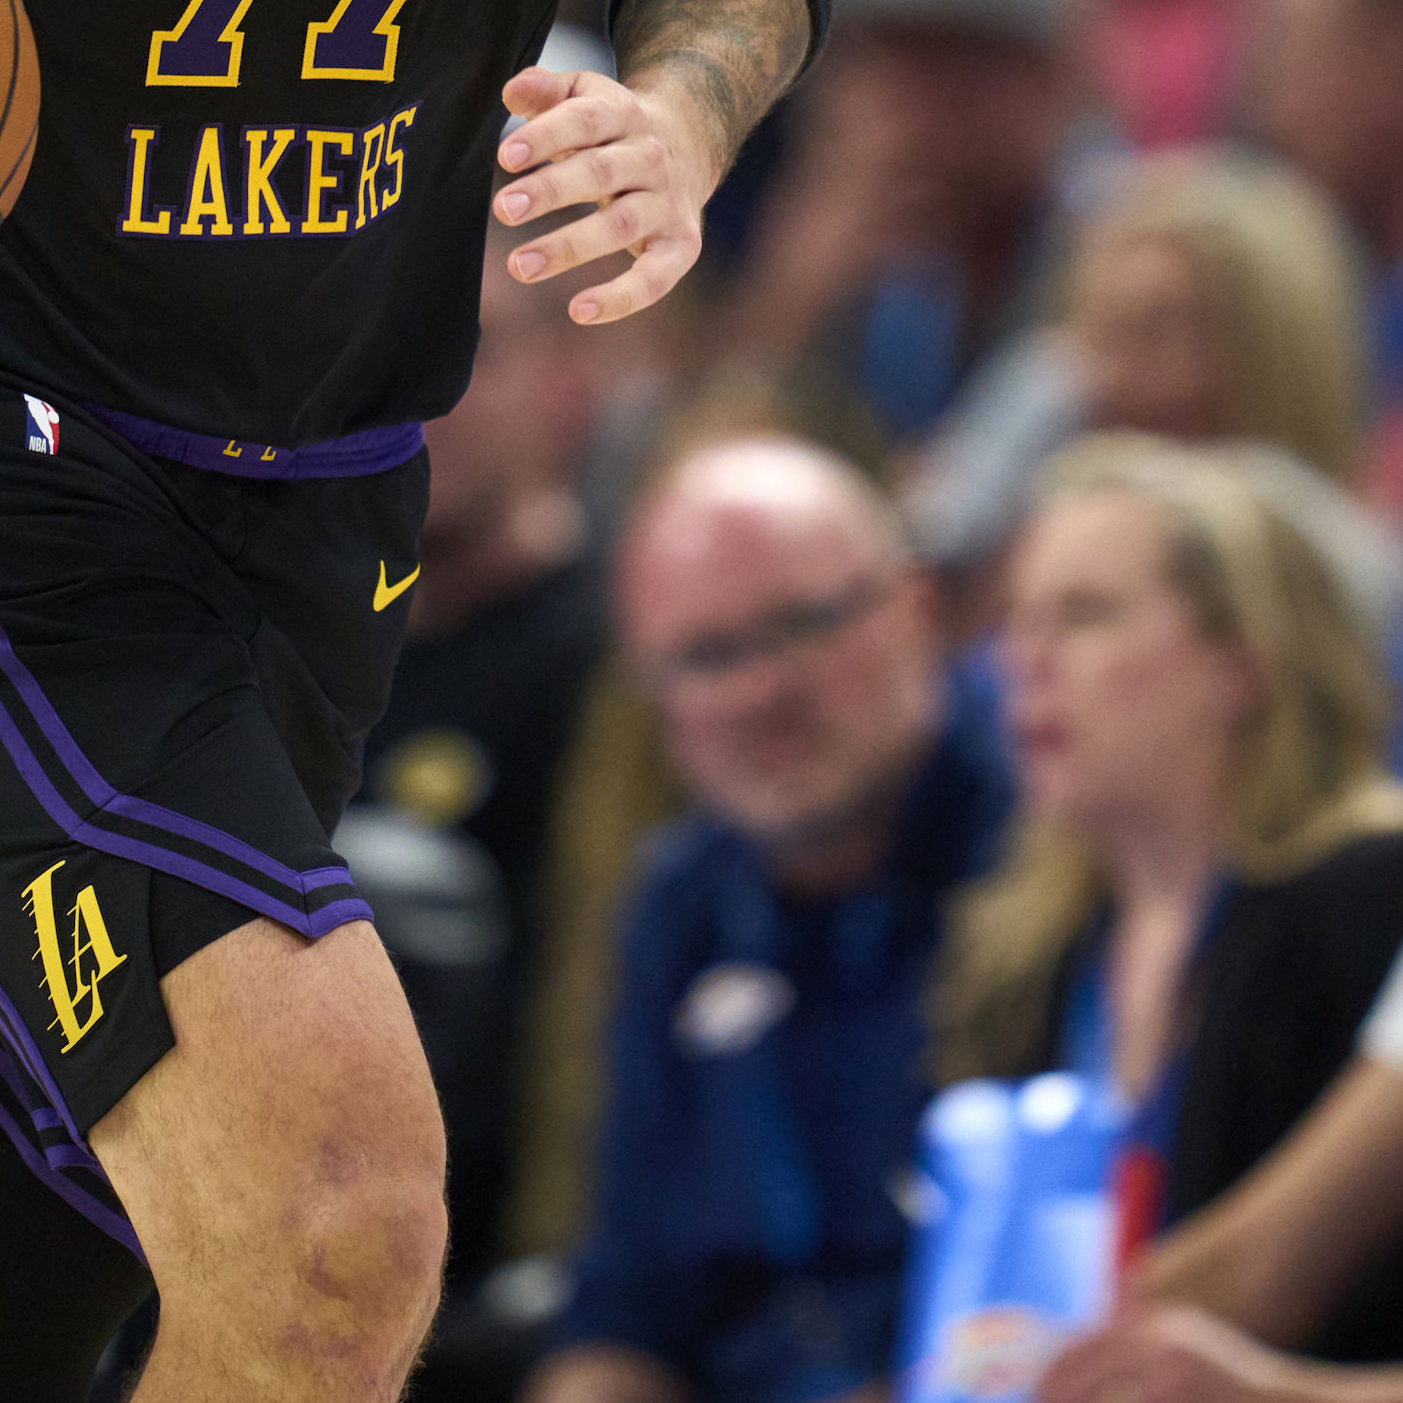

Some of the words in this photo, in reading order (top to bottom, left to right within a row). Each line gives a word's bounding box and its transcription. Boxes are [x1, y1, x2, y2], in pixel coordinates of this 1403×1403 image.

[119, 102, 421, 238] LAKERS
[28, 435, 47, 454] NBA
[20, 859, 128, 1055] LA
